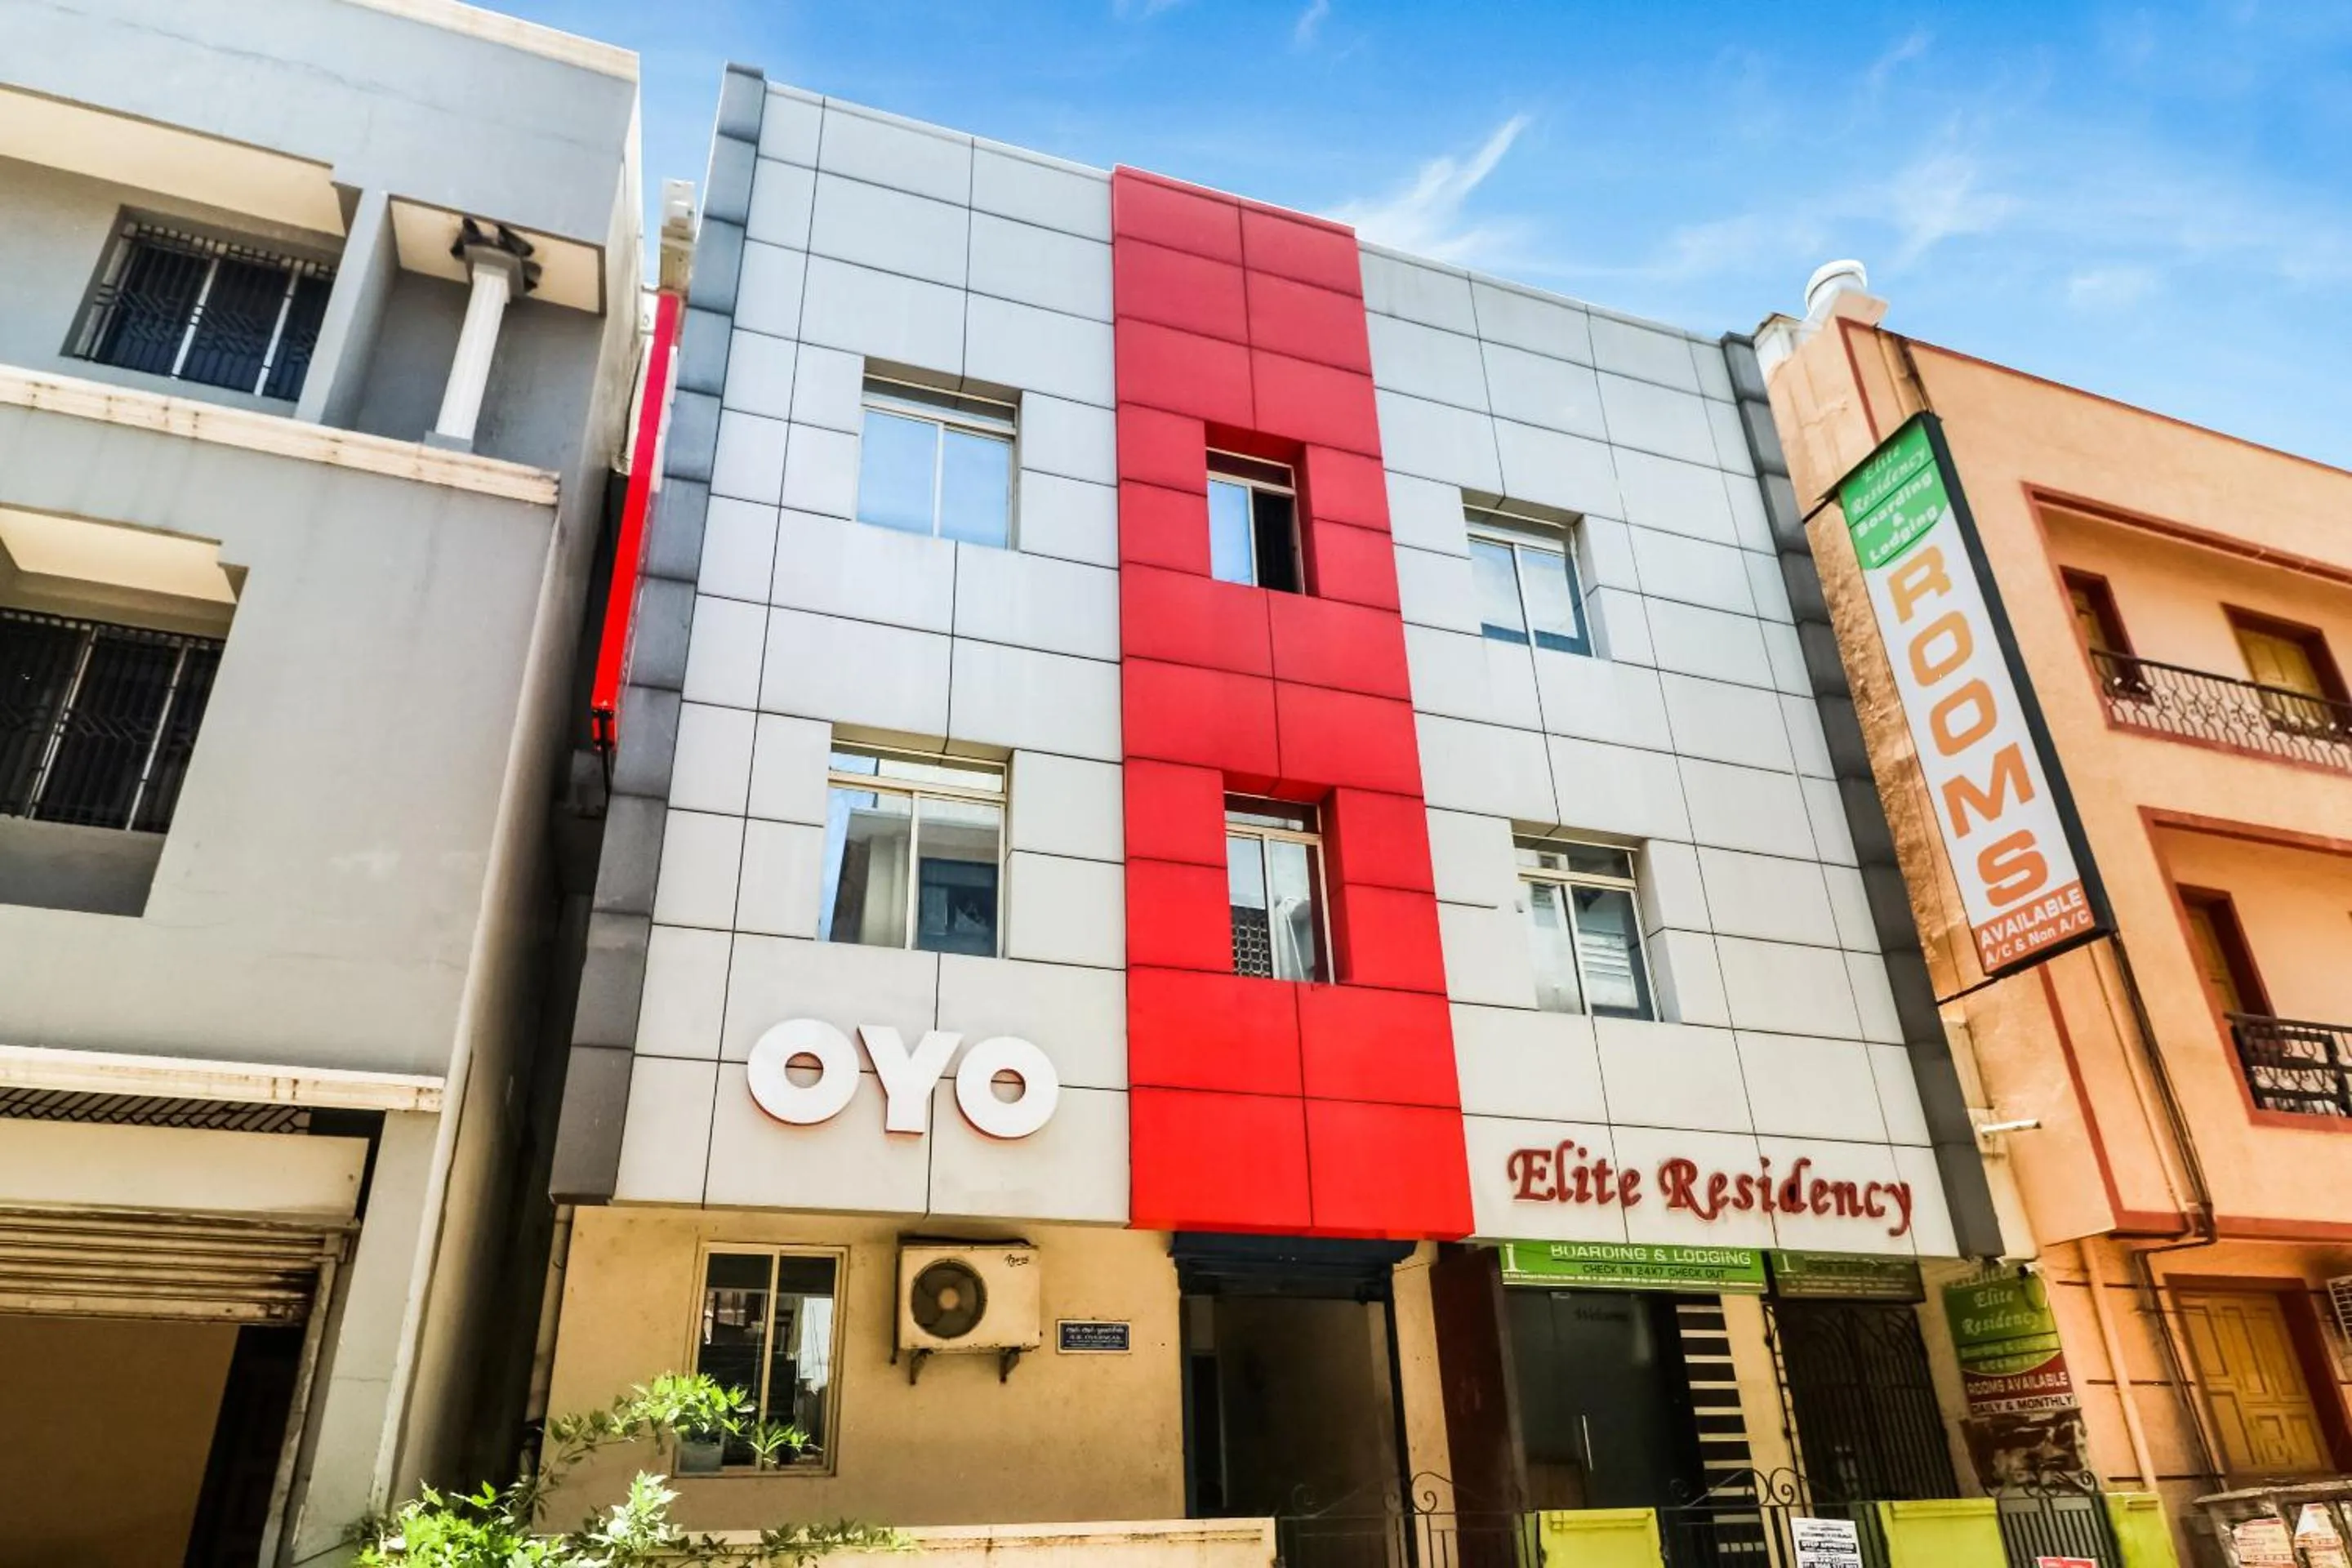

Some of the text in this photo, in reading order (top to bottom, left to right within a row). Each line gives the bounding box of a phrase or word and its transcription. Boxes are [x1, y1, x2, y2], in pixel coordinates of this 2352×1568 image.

[1851, 448, 1925, 514] Residency
[1856, 471, 1932, 538] Boarding
[1869, 506, 1938, 563] Lodging
[1891, 512, 1904, 527] &
[1887, 545, 2048, 907] ROOMS
[1980, 888, 2082, 949] AVAILABLE
[1985, 909, 2089, 967] A/C & Non A/C
[746, 1018, 1059, 1140] OYO
[1507, 1140, 1913, 1237] Elite Residency
[1551, 1245, 1751, 1265] BOARDING & LODGING
[1583, 1265, 1617, 1275] CHECK
[1622, 1266, 1633, 1275] IN
[1668, 1267, 1702, 1277] CHECK
[1705, 1269, 1726, 1278] OUT
[1962, 1311, 2038, 1335] Residency
[1974, 1287, 2014, 1307] Elite
[1967, 1371, 2068, 1395] ROOMS AVAILABLE
[1971, 1400, 2002, 1413] DAILY
[2017, 1395, 2074, 1409] MONTHLY
